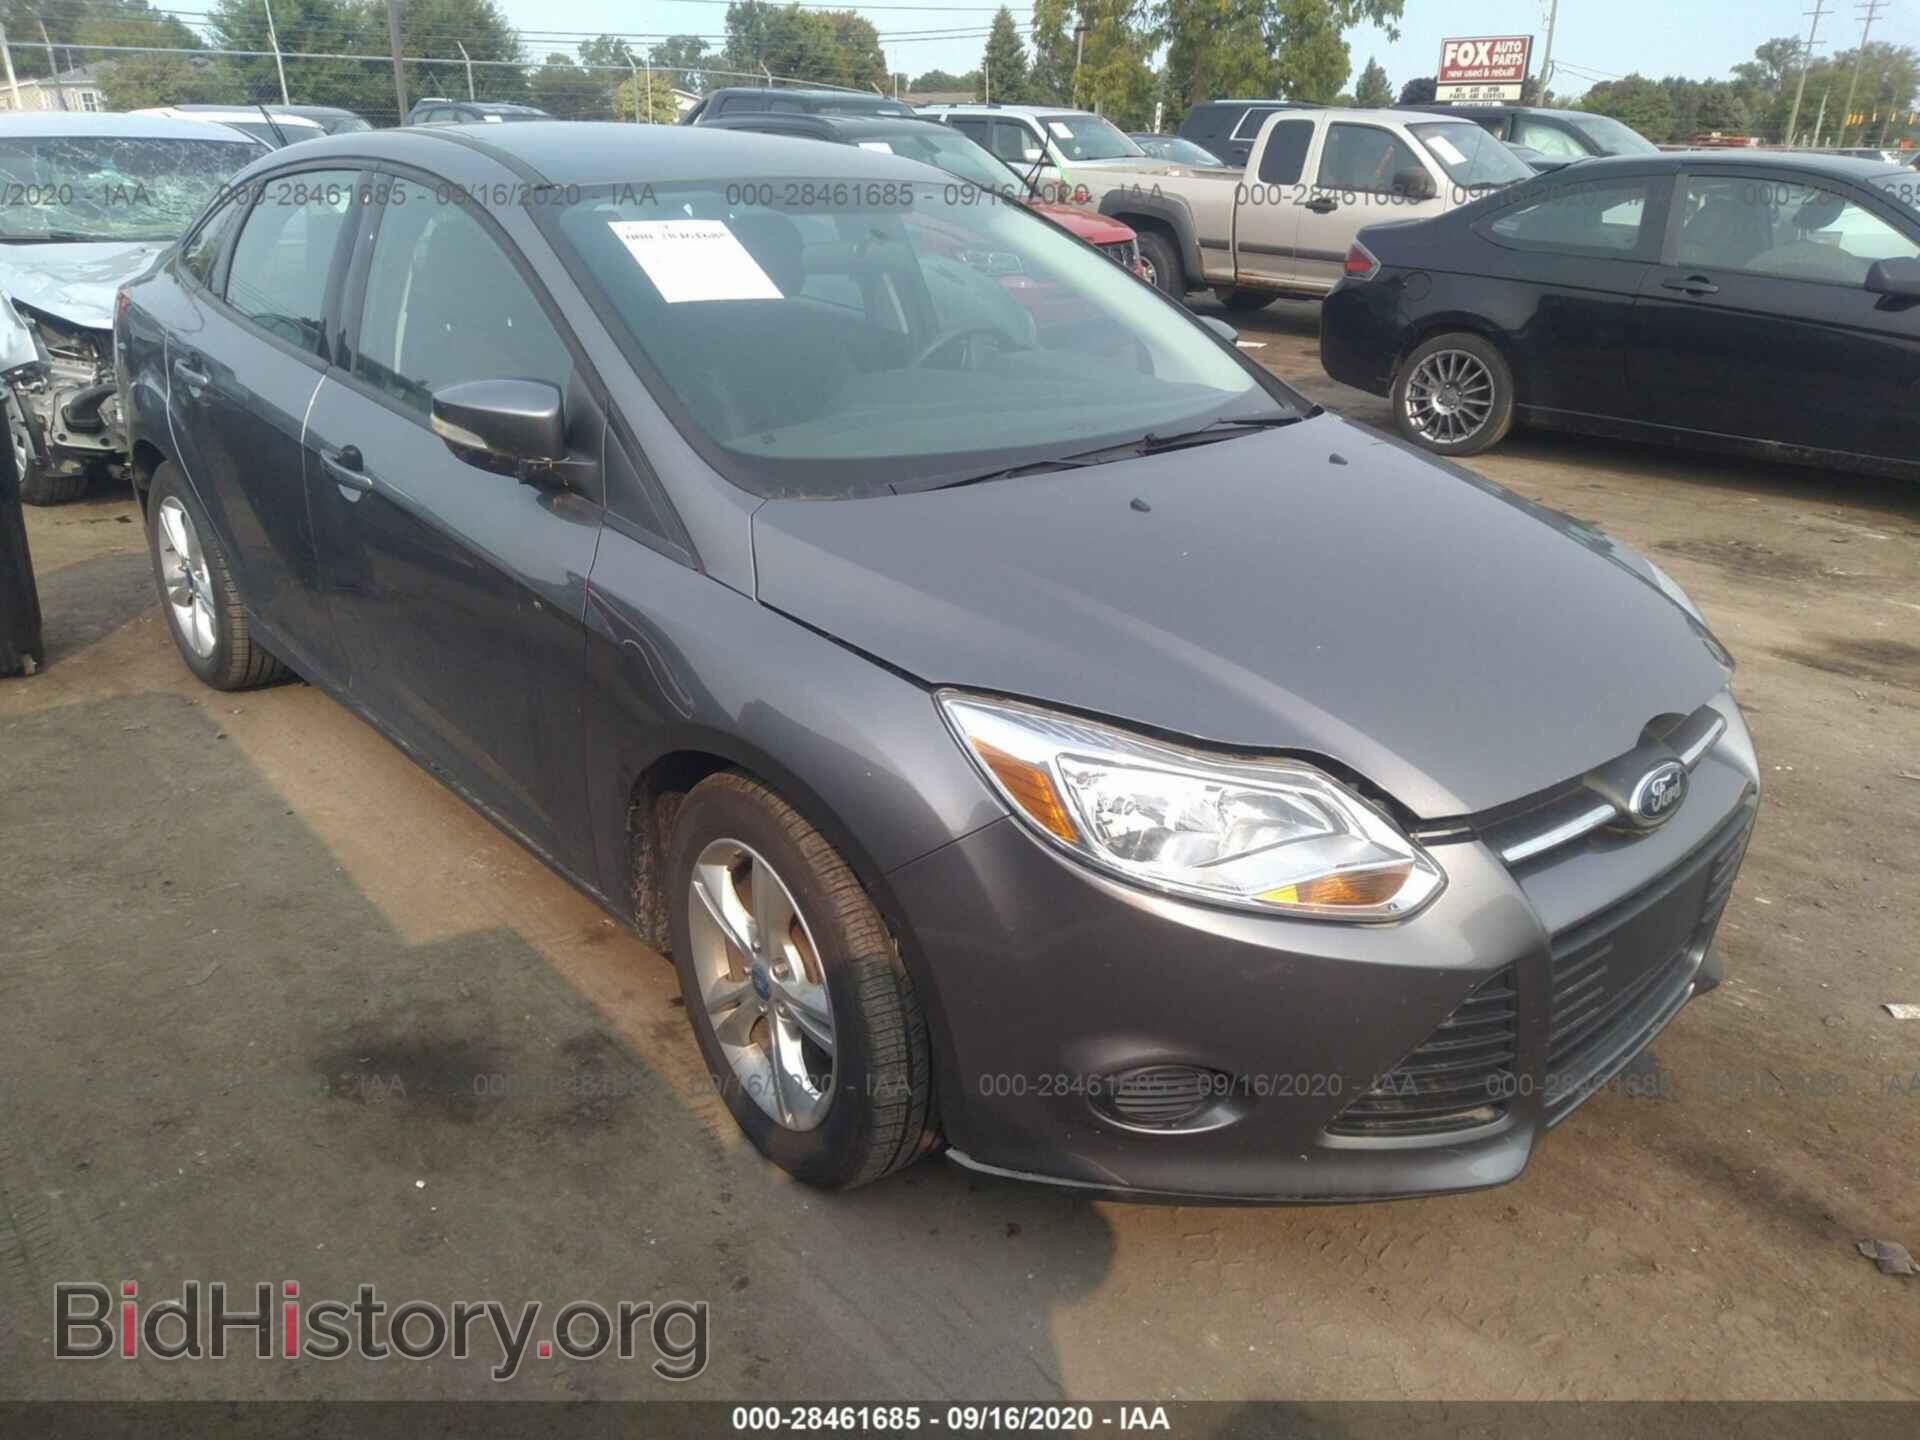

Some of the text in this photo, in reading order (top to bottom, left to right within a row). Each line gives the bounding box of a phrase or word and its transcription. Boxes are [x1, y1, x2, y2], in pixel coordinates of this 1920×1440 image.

[1443, 41, 1522, 67] FOX AUTO
[1492, 53, 1524, 66] PARTS
[1446, 67, 1516, 78] new used & rebuilt
[1651, 773, 1682, 812] Ford
